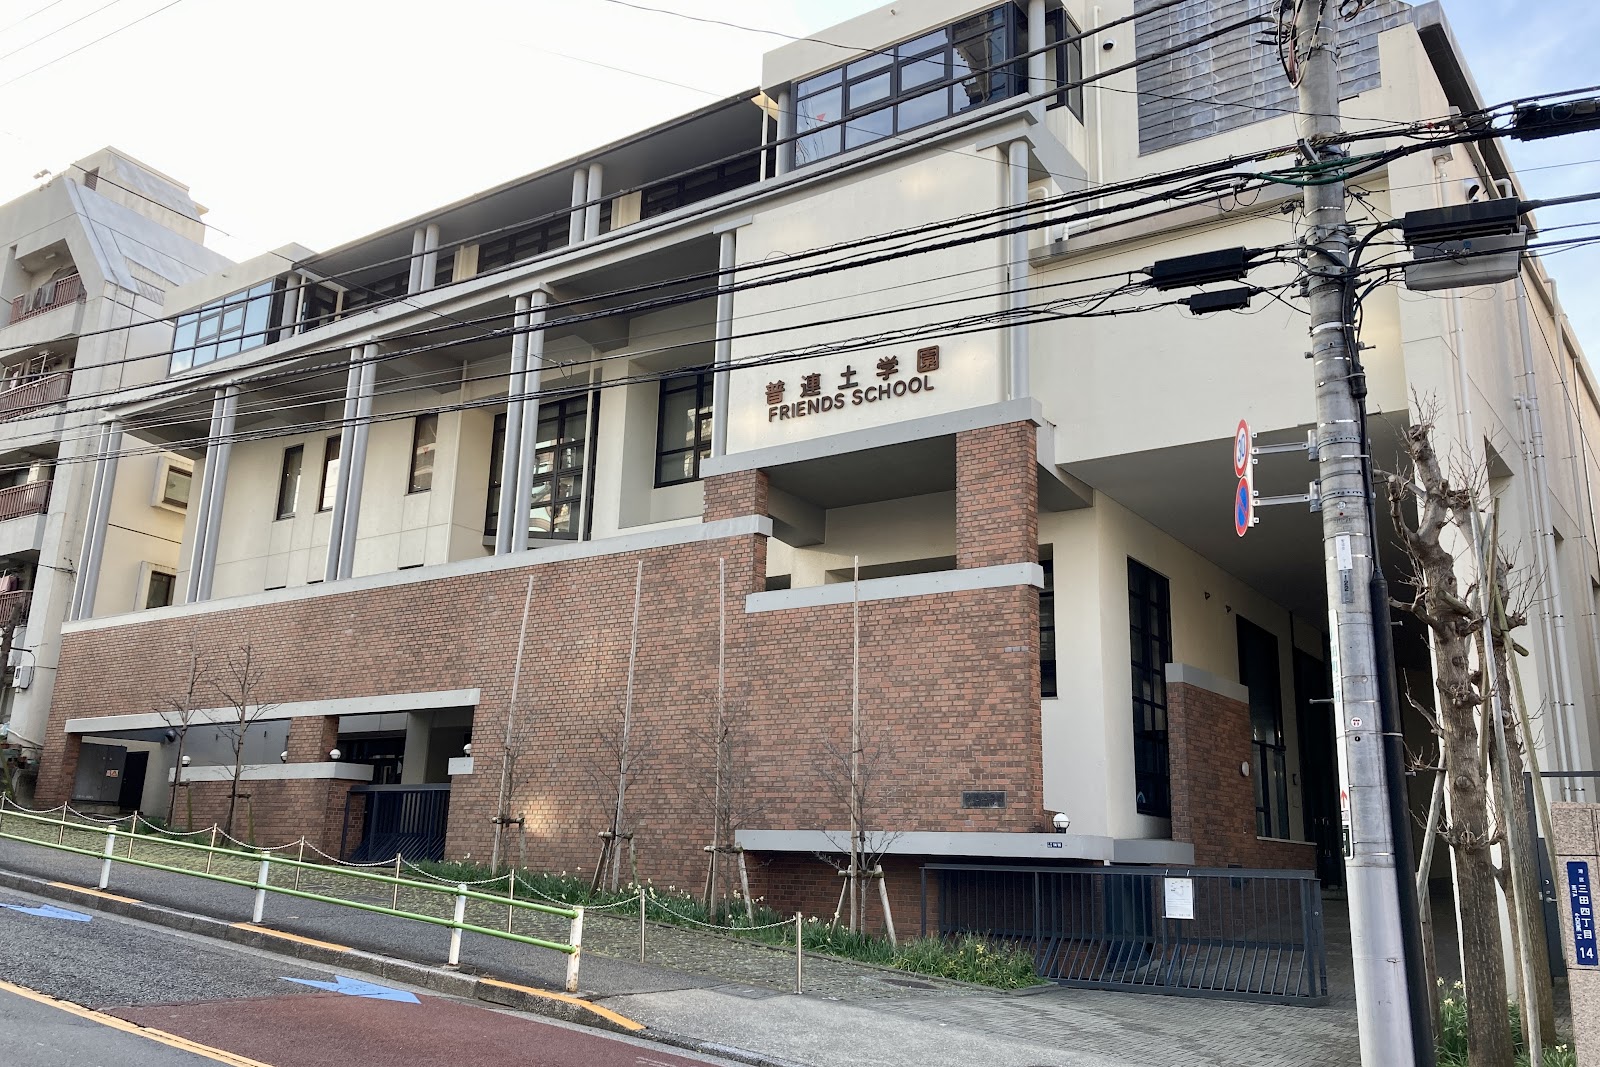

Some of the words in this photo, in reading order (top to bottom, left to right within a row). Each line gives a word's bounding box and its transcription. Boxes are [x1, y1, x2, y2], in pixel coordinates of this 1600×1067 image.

[765, 345, 940, 405] 普連土学園
[768, 392, 845, 422] FRIENDS
[851, 375, 935, 405] SCHOOL
[1237, 433, 1246, 463] 30
[1578, 884, 1592, 938] 三田四丁目
[1580, 947, 1594, 959] 14
